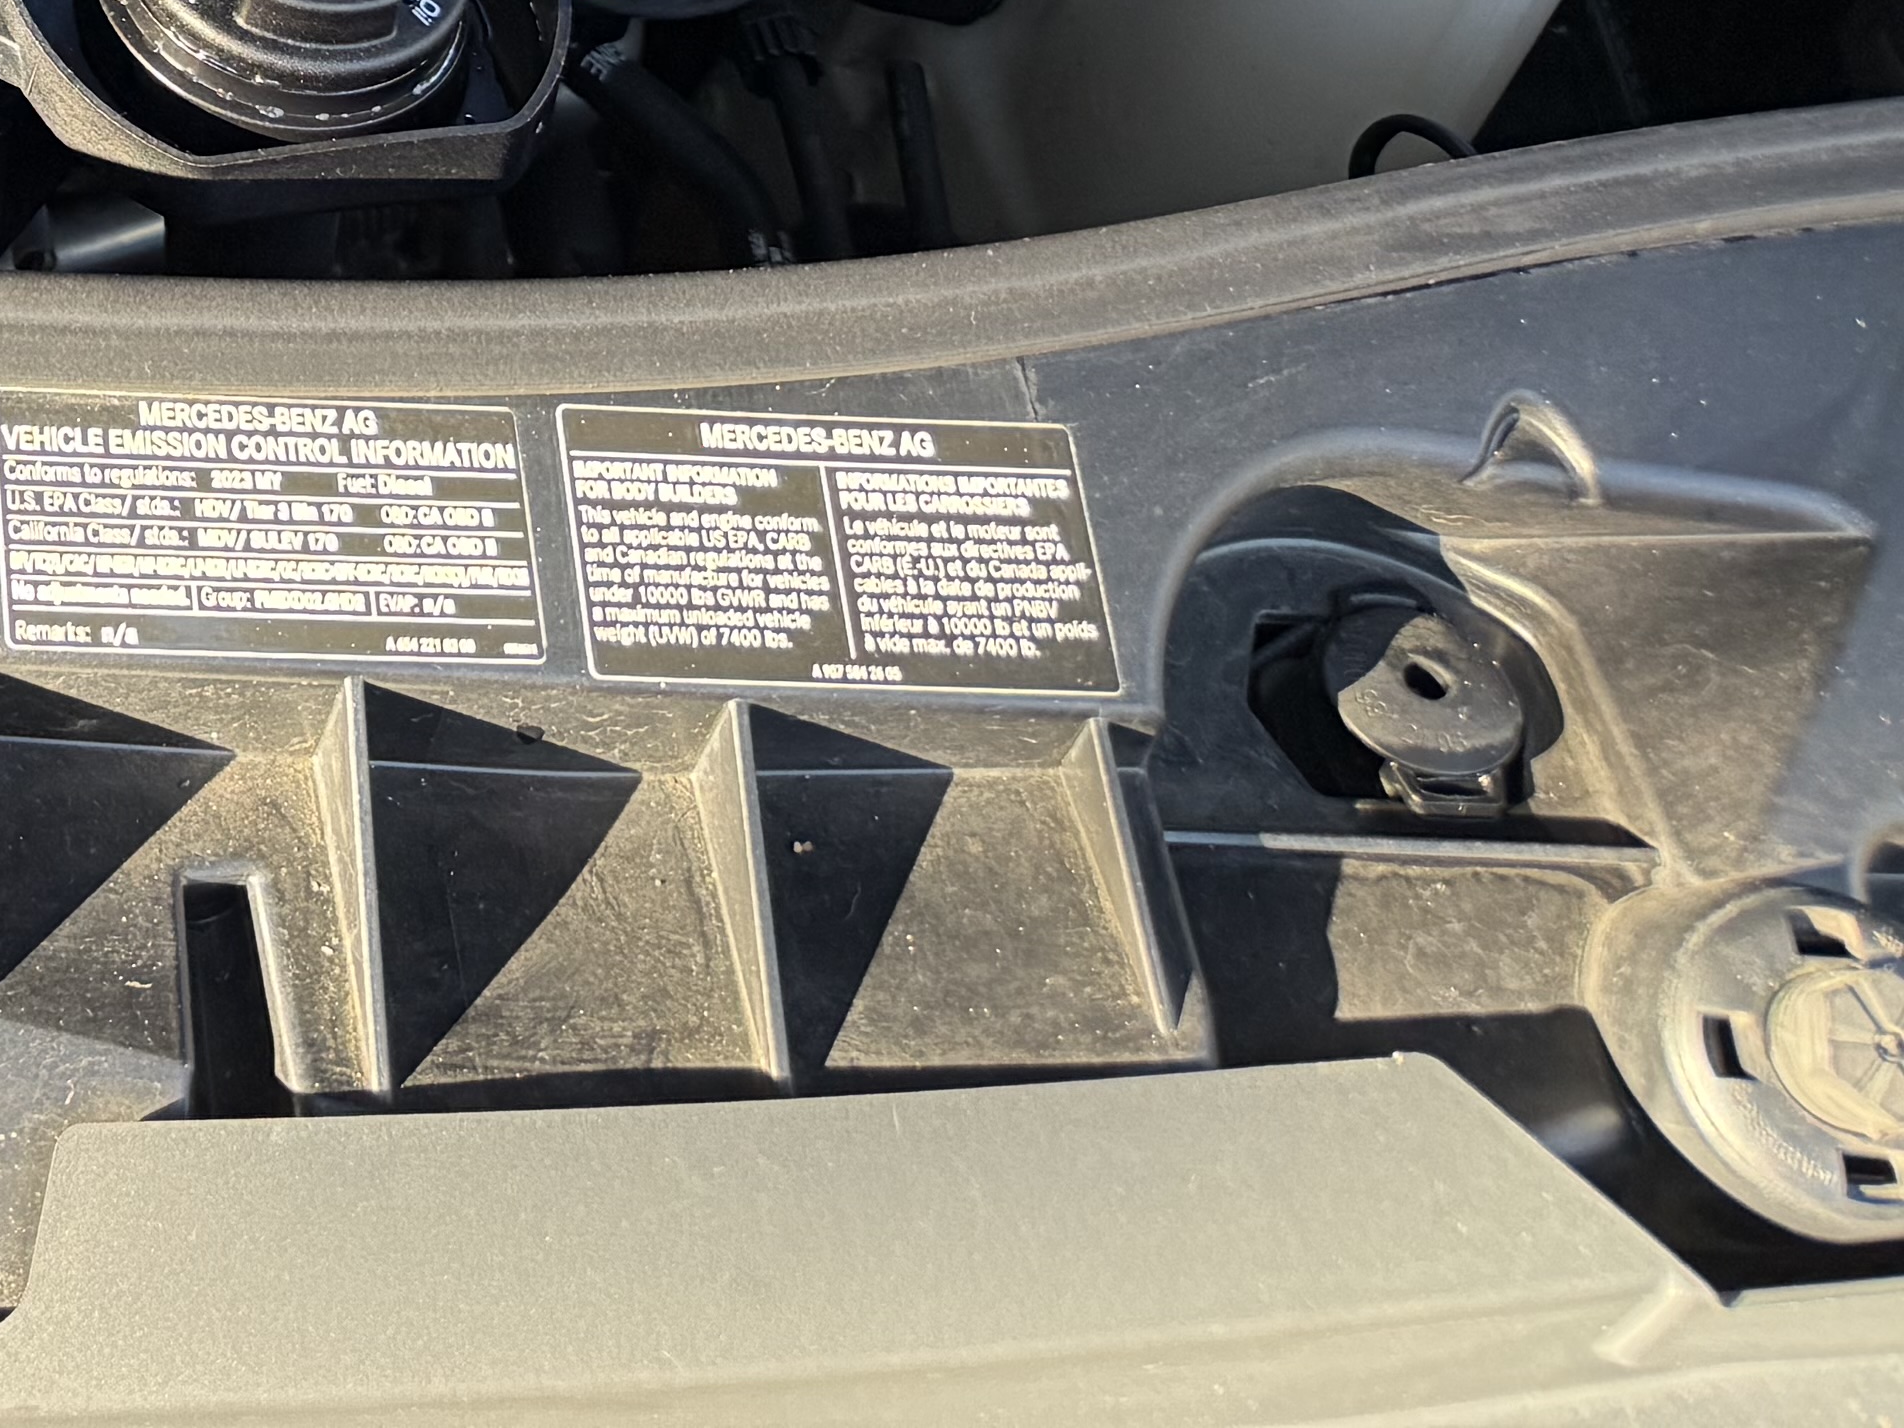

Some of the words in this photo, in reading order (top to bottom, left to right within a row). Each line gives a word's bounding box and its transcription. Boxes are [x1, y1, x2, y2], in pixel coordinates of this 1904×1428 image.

[137, 400, 340, 434] MERCEDES-BENZ
[340, 408, 378, 435] AG
[0, 423, 105, 455] VEHICLE
[107, 427, 228, 460] EMISSION
[229, 432, 349, 464] CONTROL
[349, 437, 516, 471] INFORMATION
[698, 421, 897, 456] MERCEDES-BENZ
[895, 429, 936, 458] AG
[2, 459, 82, 483] Conforms
[83, 462, 103, 484] to
[102, 462, 197, 491] regulations:
[209, 467, 253, 489] 2023
[571, 459, 666, 482] IMPORTANT
[574, 478, 611, 500] FOR
[609, 480, 658, 501] BODY
[884, 491, 919, 512] LES
[5, 488, 41, 511] U.S.
[42, 490, 78, 513] EPA
[77, 491, 134, 517] Class/
[320, 500, 354, 523] 170
[577, 504, 613, 524] This
[611, 506, 668, 527] vehicle
[667, 508, 700, 528] and
[698, 509, 754, 533] engine
[7, 518, 85, 543] California
[306, 529, 339, 552] 170
[580, 524, 601, 544] to
[599, 525, 621, 545] all
[700, 529, 727, 549] US
[764, 531, 812, 552] CARB
[841, 515, 864, 535] Le
[928, 518, 949, 538] et
[948, 519, 967, 539] le
[965, 520, 1024, 541] moteur
[1022, 522, 1061, 543] sont
[582, 544, 616, 563] and
[614, 545, 688, 566] Canadian
[688, 548, 776, 573] regulations
[774, 551, 795, 570] at
[794, 552, 823, 571] the
[848, 554, 896, 575] CARB
[945, 558, 966, 577] et
[964, 559, 988, 578] du
[986, 560, 1048, 581] Canada
[585, 563, 622, 583] time
[622, 565, 643, 584] of
[740, 570, 766, 589] for
[765, 570, 831, 592] vehicles
[935, 577, 973, 597] date
[972, 579, 996, 598] de
[995, 580, 1082, 603] production
[198, 586, 252, 610] Group:
[587, 583, 634, 603] under
[637, 585, 689, 605] 10000
[689, 587, 715, 606] lbs
[715, 588, 766, 608] GVWR
[766, 590, 801, 610] and
[799, 591, 830, 611] has
[855, 593, 879, 613] du
[989, 598, 1013, 618] un
[1011, 599, 1060, 620] PNBV
[604, 603, 681, 625] maximum
[681, 606, 755, 628] unloaded
[754, 609, 812, 630] vehicle
[940, 615, 993, 637] 10000
[1010, 617, 1031, 638] et
[1030, 618, 1053, 639] un
[1052, 619, 1101, 643] poids
[13, 619, 92, 643] Remarks:
[592, 622, 649, 646] weight
[699, 626, 720, 646] of
[718, 627, 763, 648] 7400
[950, 636, 975, 656] de
[973, 637, 1020, 658] 7400
